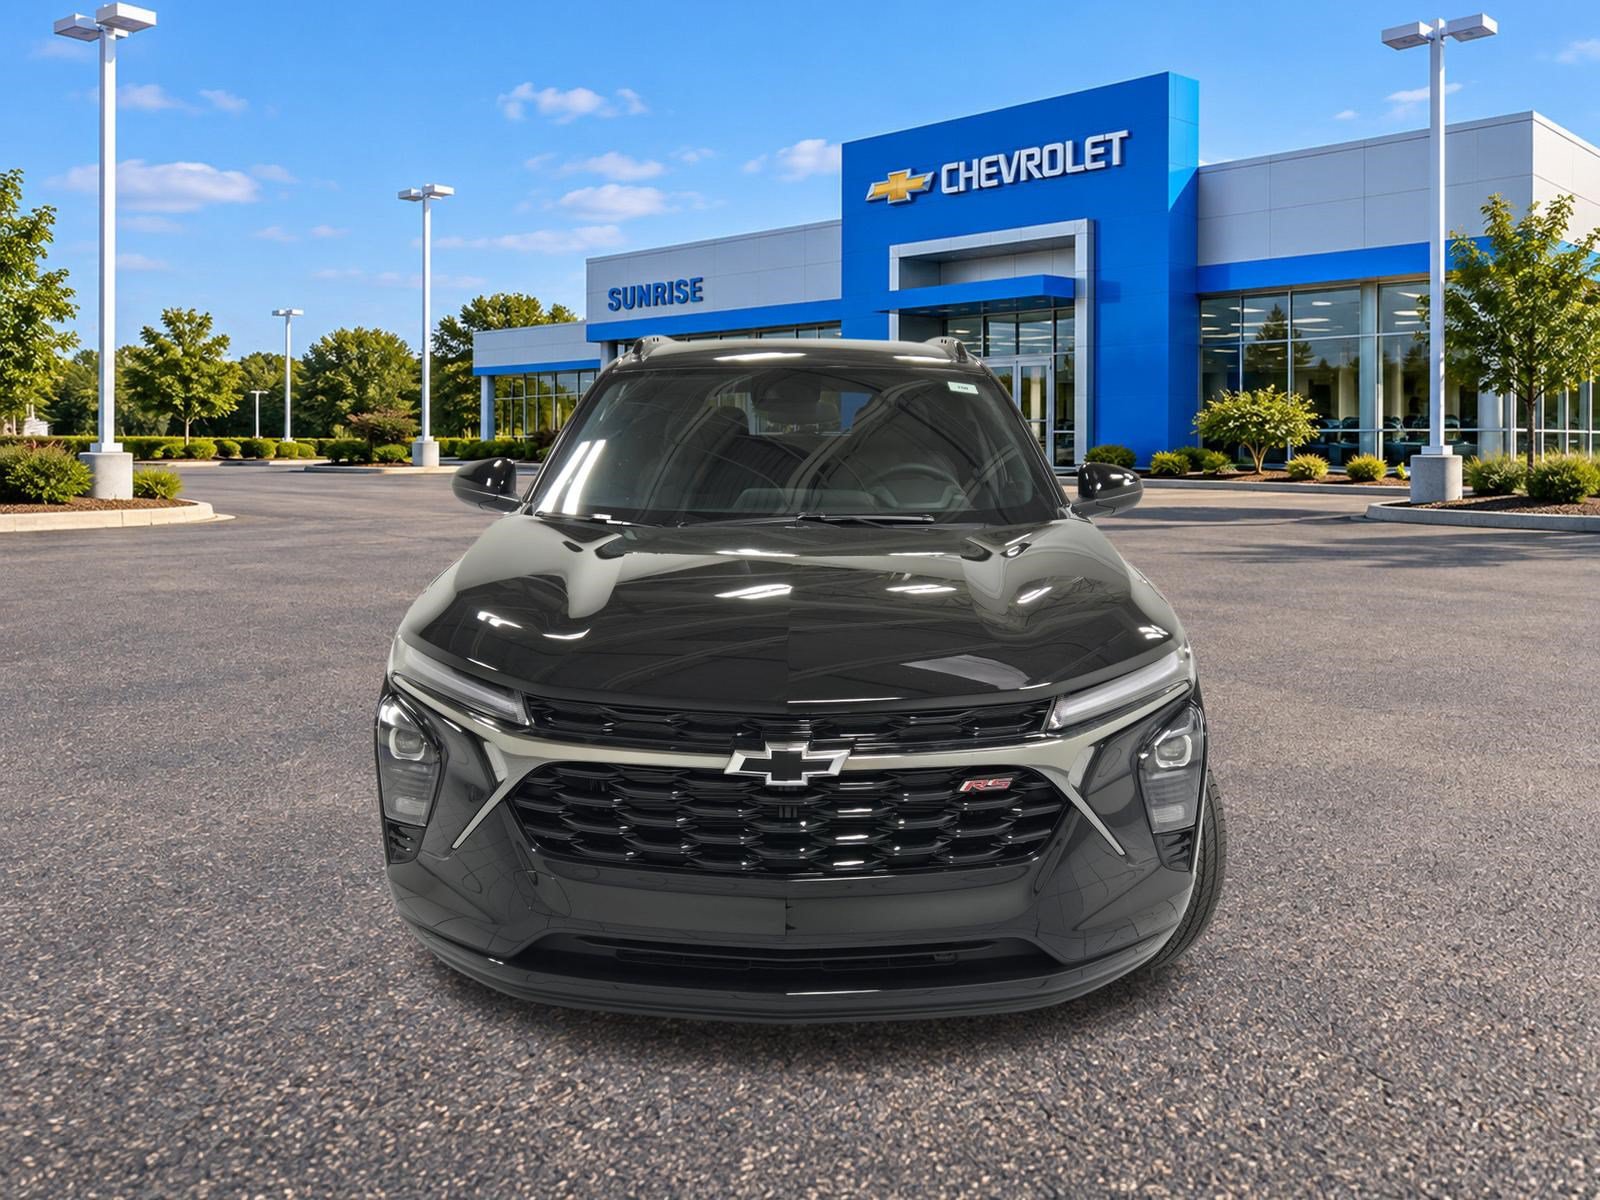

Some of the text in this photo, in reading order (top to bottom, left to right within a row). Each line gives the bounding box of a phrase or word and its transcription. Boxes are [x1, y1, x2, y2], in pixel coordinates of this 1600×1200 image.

[940, 129, 1129, 194] CHEVROLET
[608, 277, 704, 312] SUNRISE
[960, 777, 1013, 792] RS
